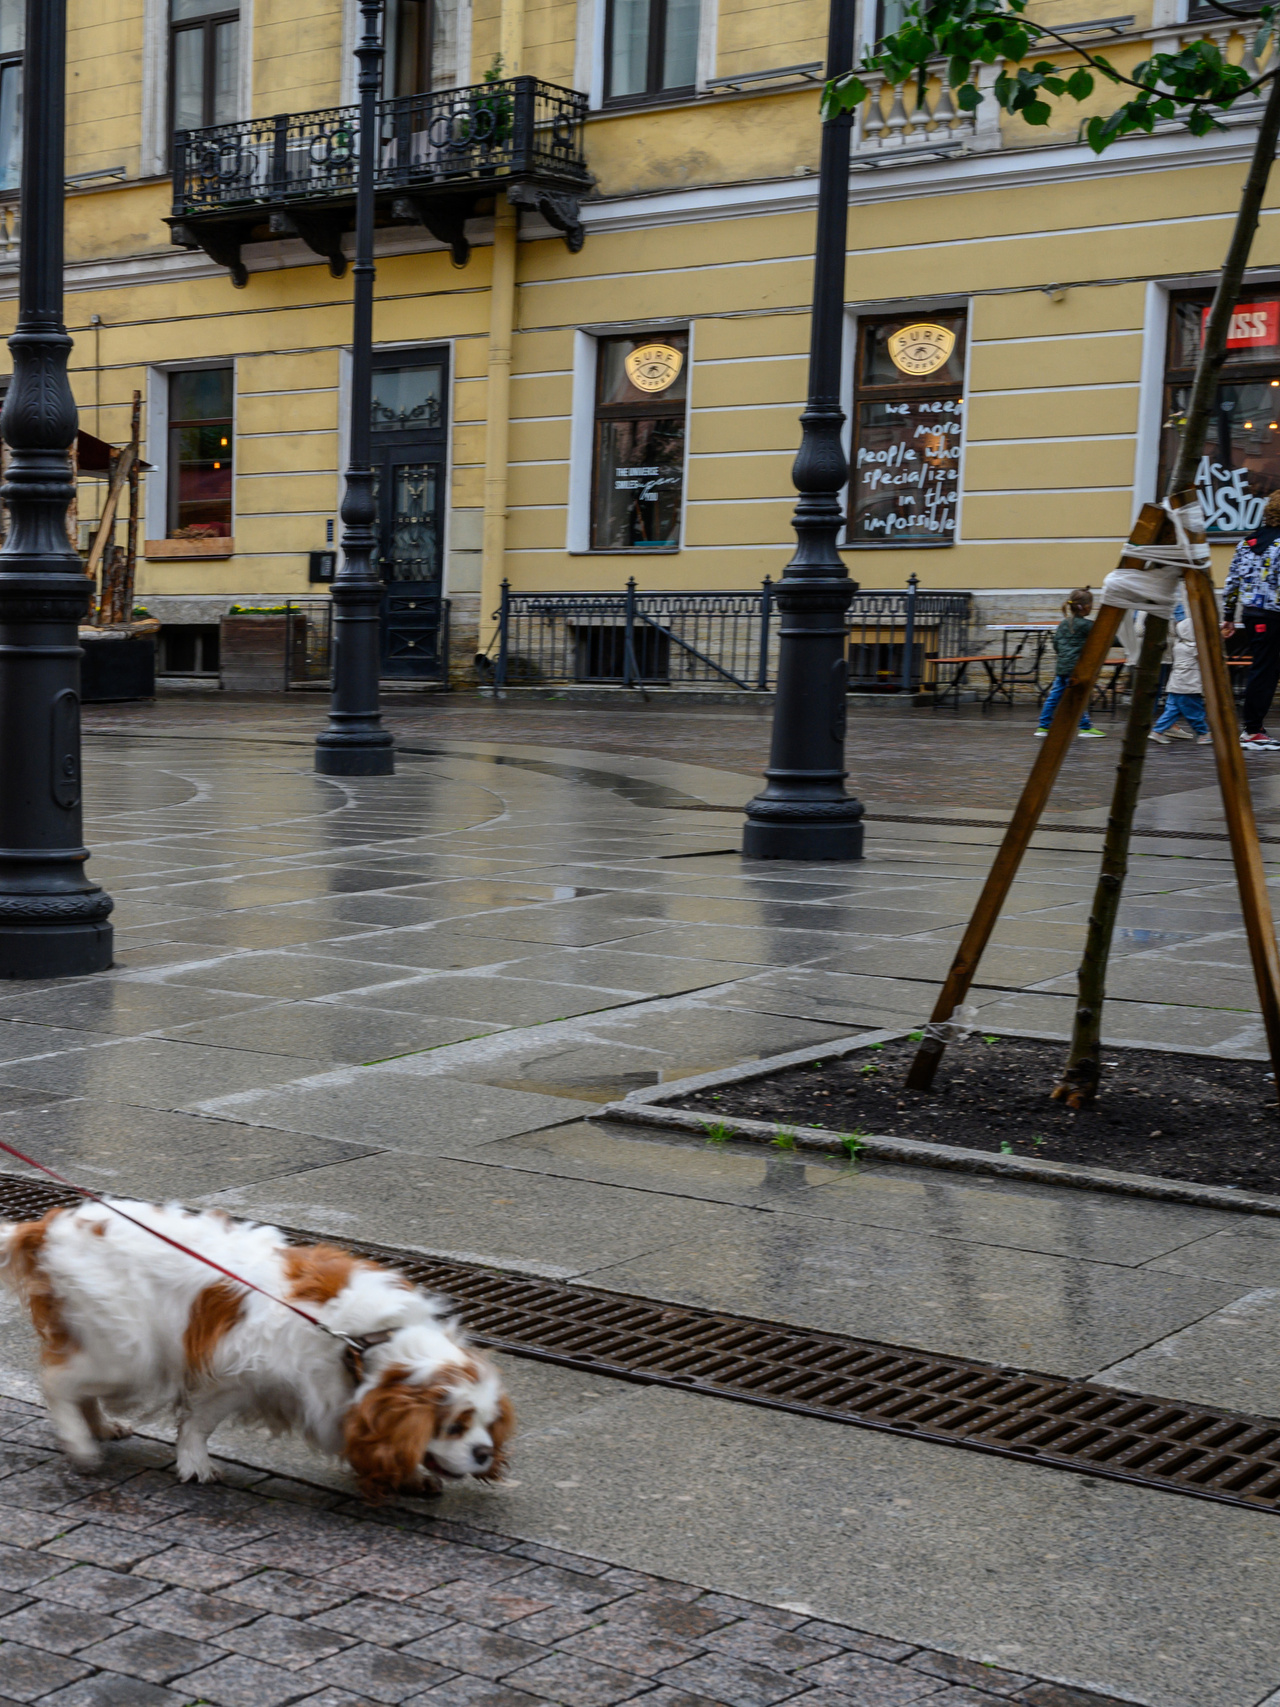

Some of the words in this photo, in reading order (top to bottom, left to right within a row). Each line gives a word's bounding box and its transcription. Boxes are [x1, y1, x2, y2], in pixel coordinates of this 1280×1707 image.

[899, 330, 945, 347] SURF
[634, 351, 674, 366] SURF
[900, 354, 941, 369] COFFEE
[636, 373, 671, 386] COFFEE
[885, 403, 911, 414] we
[913, 421, 962, 438] more
[856, 441, 917, 469] people
[925, 435, 961, 459] who
[861, 463, 960, 490] specialize
[898, 495, 916, 507] in
[923, 481, 959, 507] the
[863, 507, 958, 535] impossible
